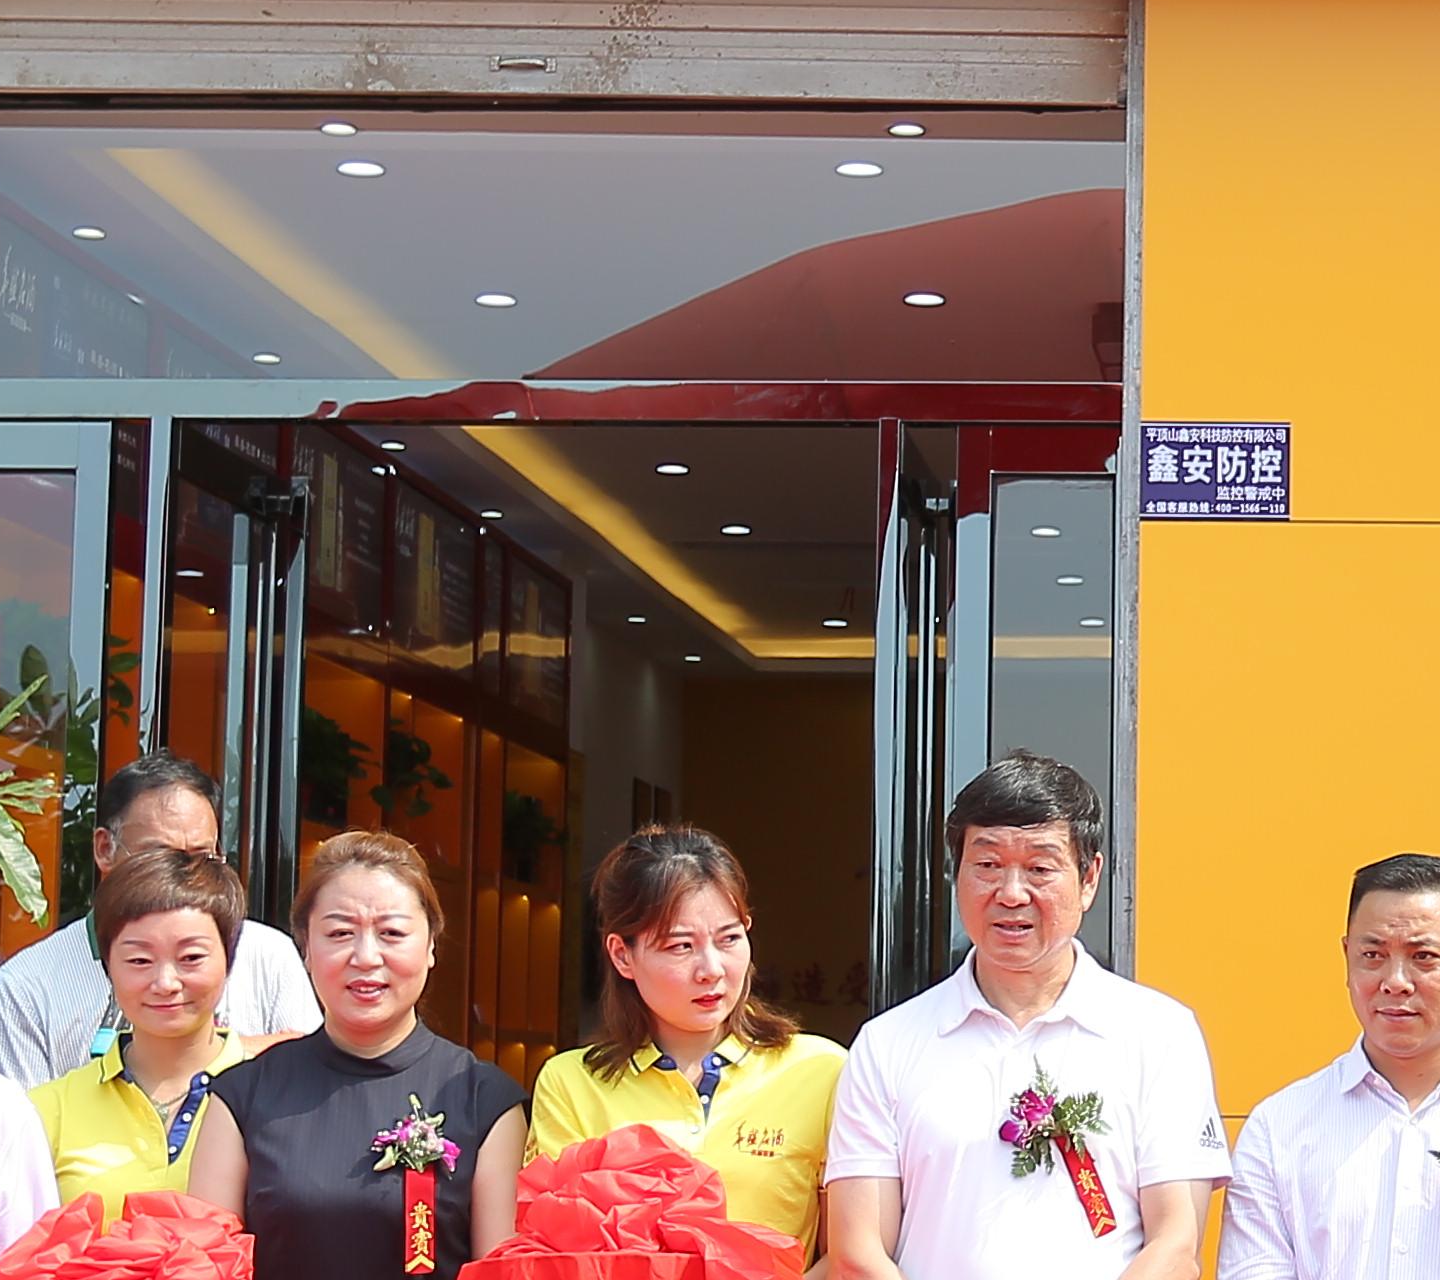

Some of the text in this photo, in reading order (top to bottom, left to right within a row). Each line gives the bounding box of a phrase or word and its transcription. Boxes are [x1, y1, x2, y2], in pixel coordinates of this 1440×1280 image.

[1145, 428, 1287, 443] 平顶山鑫安科技防控有限公司
[1147, 445, 1283, 483] 鑫安防控
[1216, 486, 1286, 501] 监控警戒中
